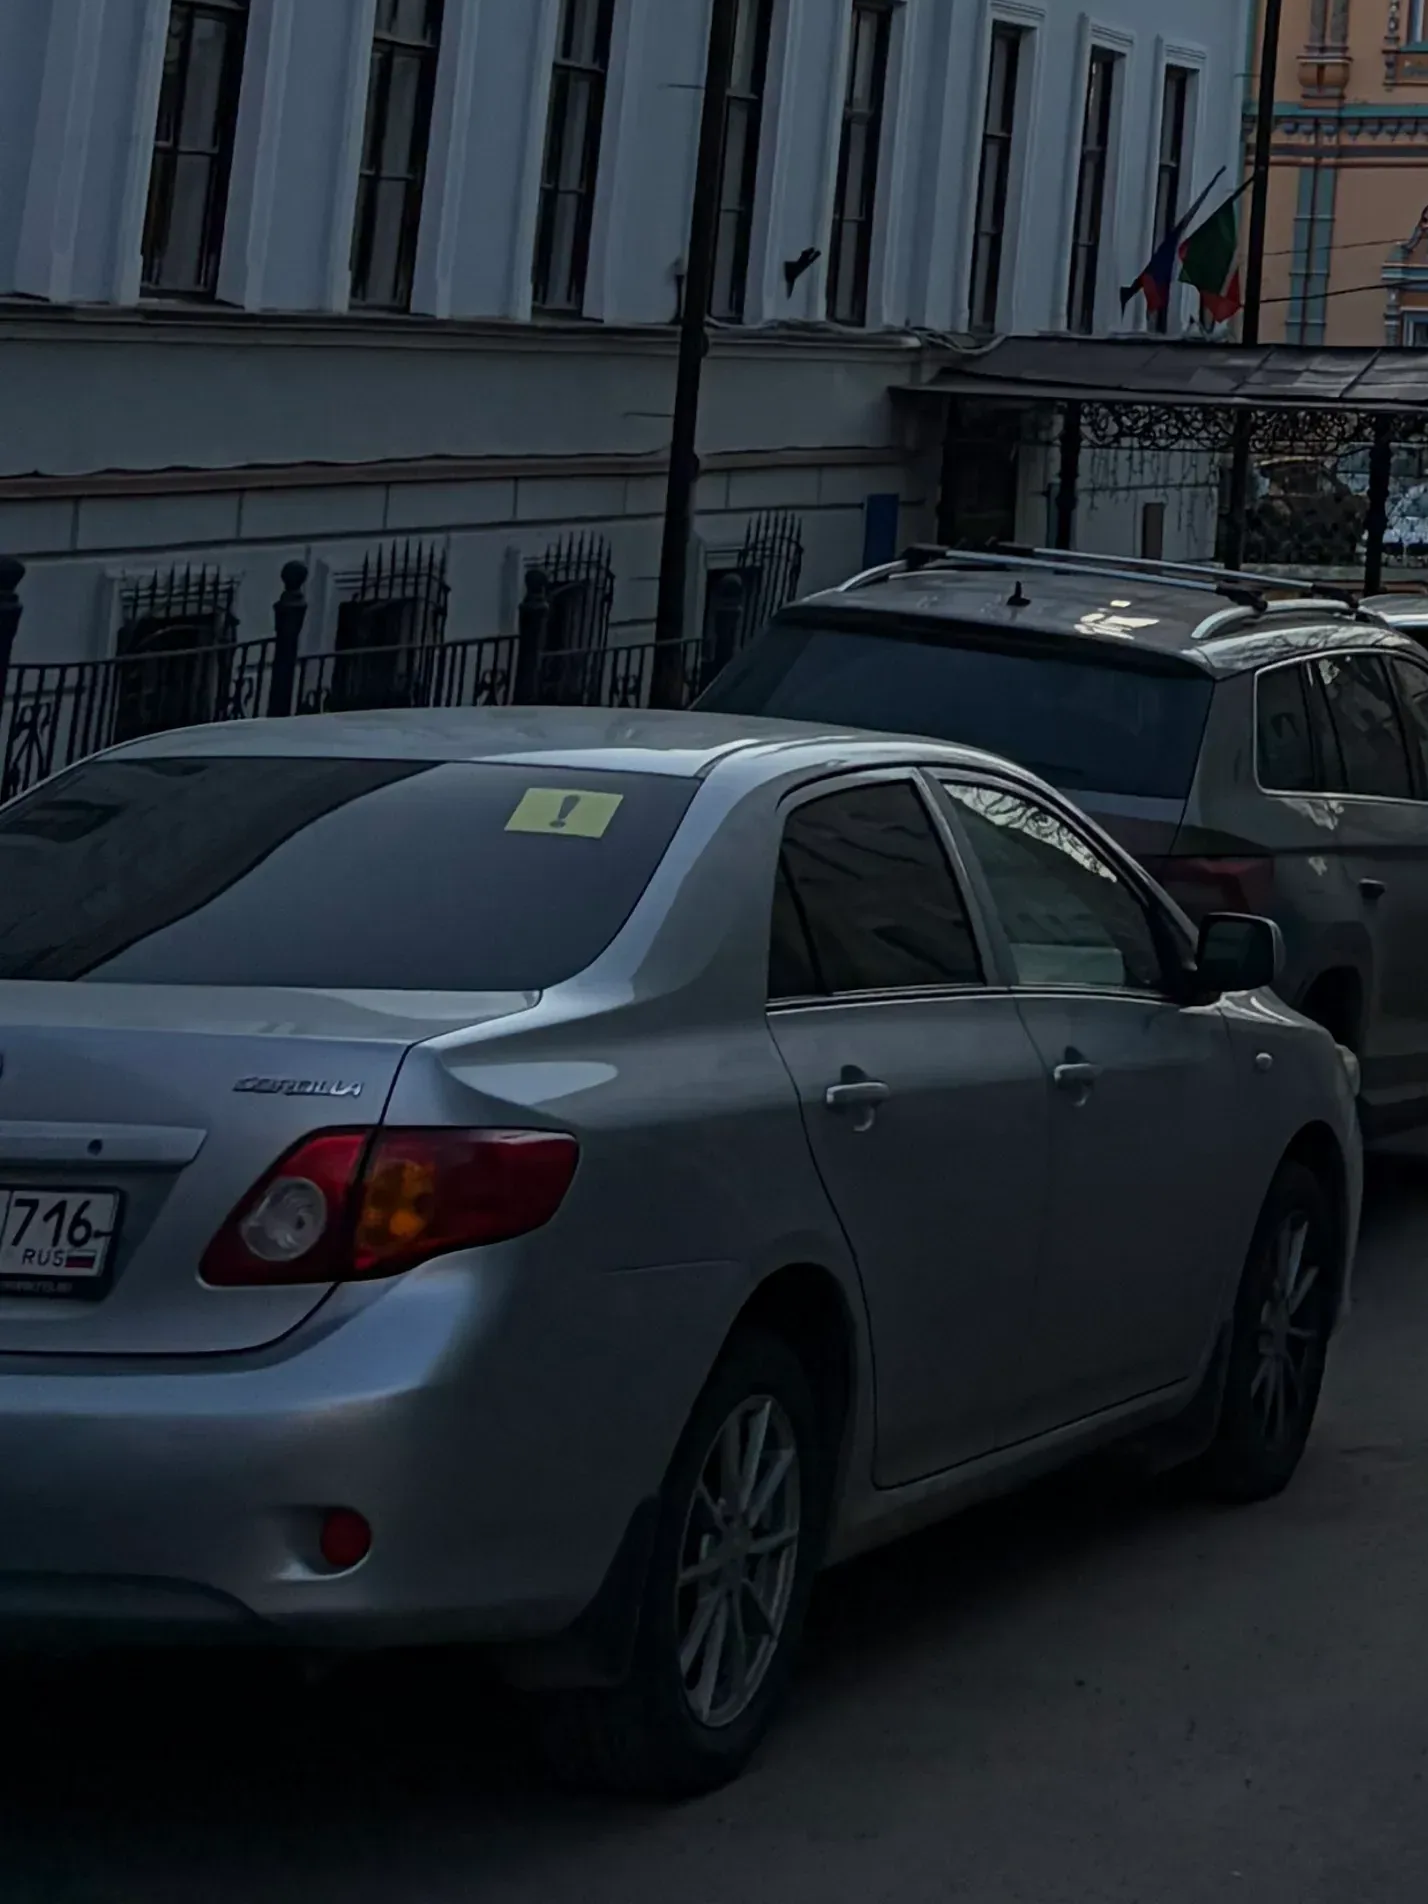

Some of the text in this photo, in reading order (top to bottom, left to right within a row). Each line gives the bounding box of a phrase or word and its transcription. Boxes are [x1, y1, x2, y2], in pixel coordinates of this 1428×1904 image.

[232, 1076, 365, 1098] COROLLA
[11, 1198, 92, 1248] 716
[21, 1248, 65, 1267] RUS
